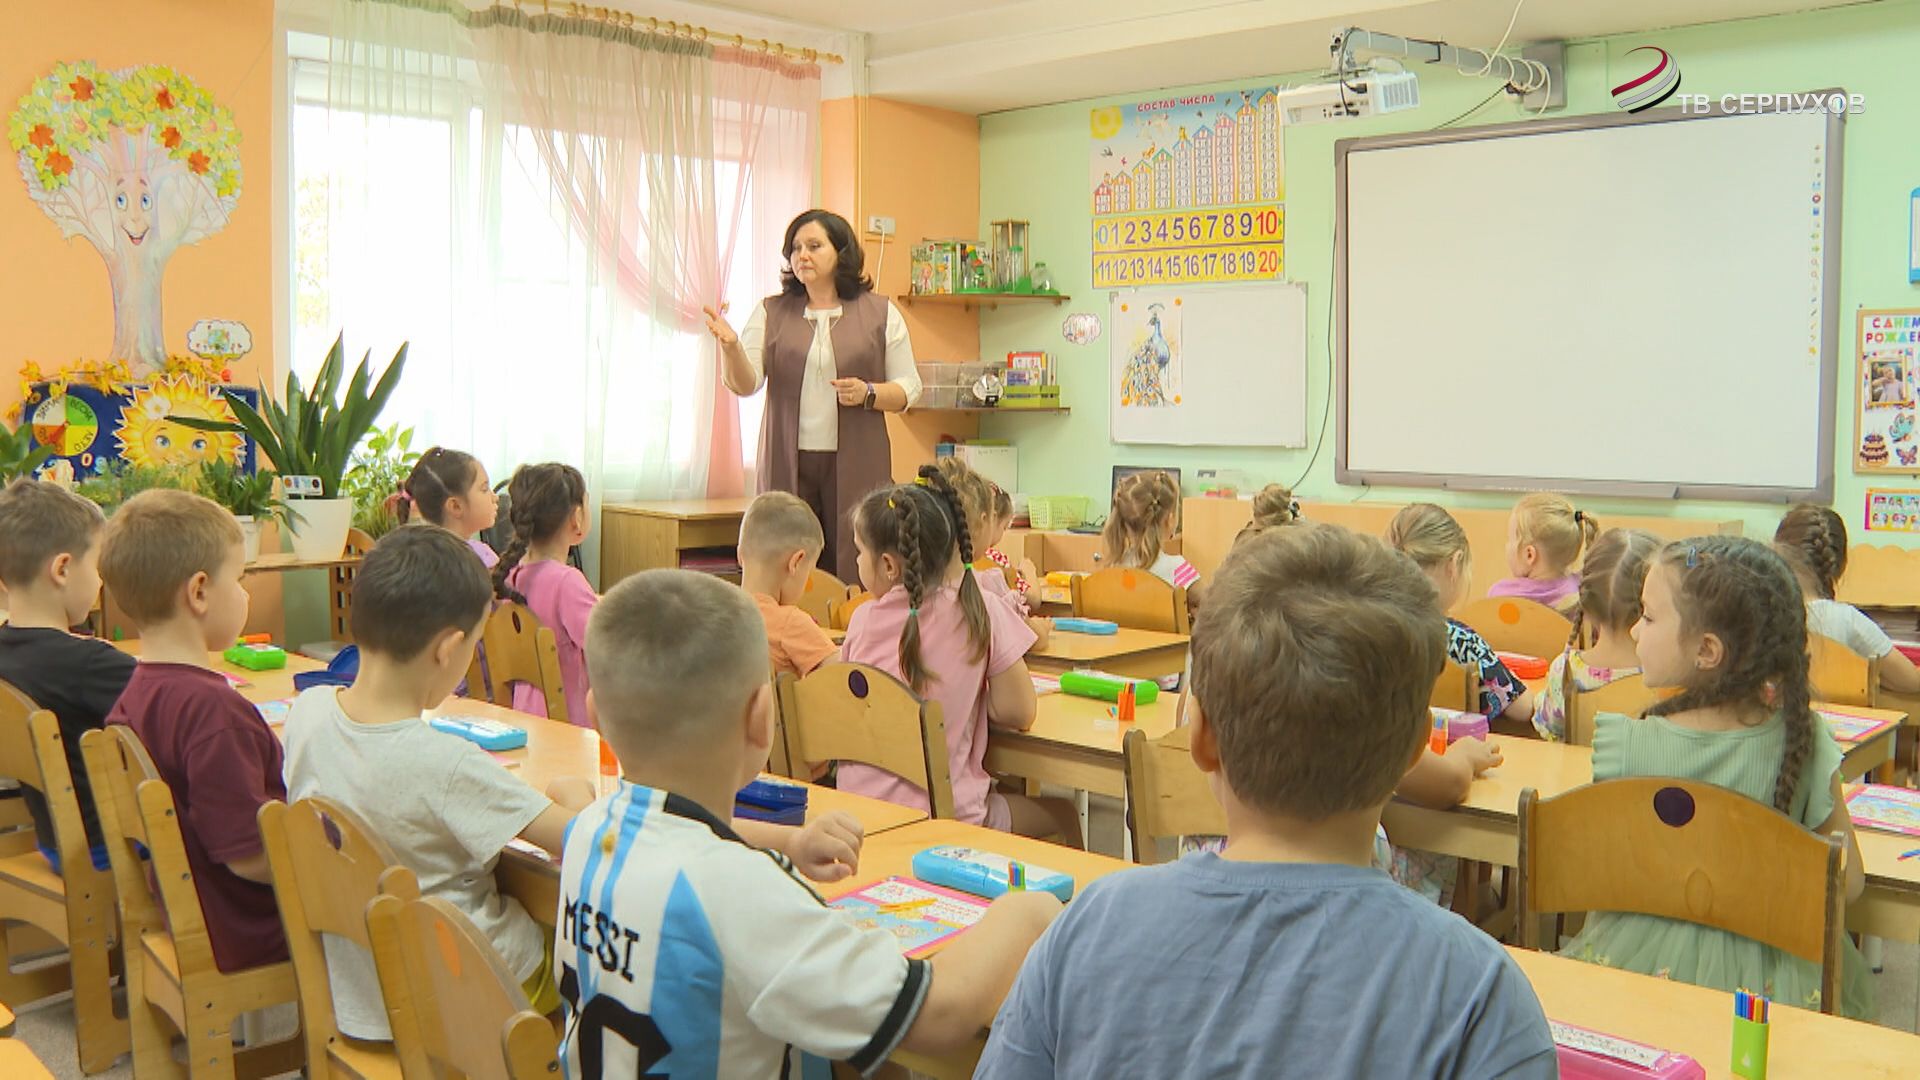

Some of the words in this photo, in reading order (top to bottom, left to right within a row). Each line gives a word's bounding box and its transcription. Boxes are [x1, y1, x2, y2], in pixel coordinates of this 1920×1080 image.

[1137, 100, 1176, 112] СОСТАВ
[1180, 94, 1216, 106] ЧИСЛА
[1099, 225, 1108, 244] 0
[1112, 223, 1119, 244] 1
[1125, 221, 1136, 244] 2
[1141, 220, 1152, 243] 3
[1156, 219, 1168, 241] 4
[1173, 217, 1184, 240] 5
[1190, 216, 1201, 239] 6
[1207, 216, 1218, 238] 7
[1224, 214, 1234, 237] 8
[1240, 213, 1252, 236] 9
[1256, 211, 1277, 235] 10
[1099, 261, 1113, 280] 11
[1114, 259, 1127, 280] 12
[1130, 258, 1144, 279] 13
[1148, 257, 1163, 277] 14
[1166, 255, 1180, 276] 15
[1184, 254, 1199, 276] 16
[1203, 254, 1217, 275] 17
[1221, 252, 1236, 274] 18
[1240, 252, 1255, 273] 19
[1259, 251, 1277, 272] 20
[1866, 330, 1920, 344] РОЖДЕ
[563, 892, 640, 983] MESSI
